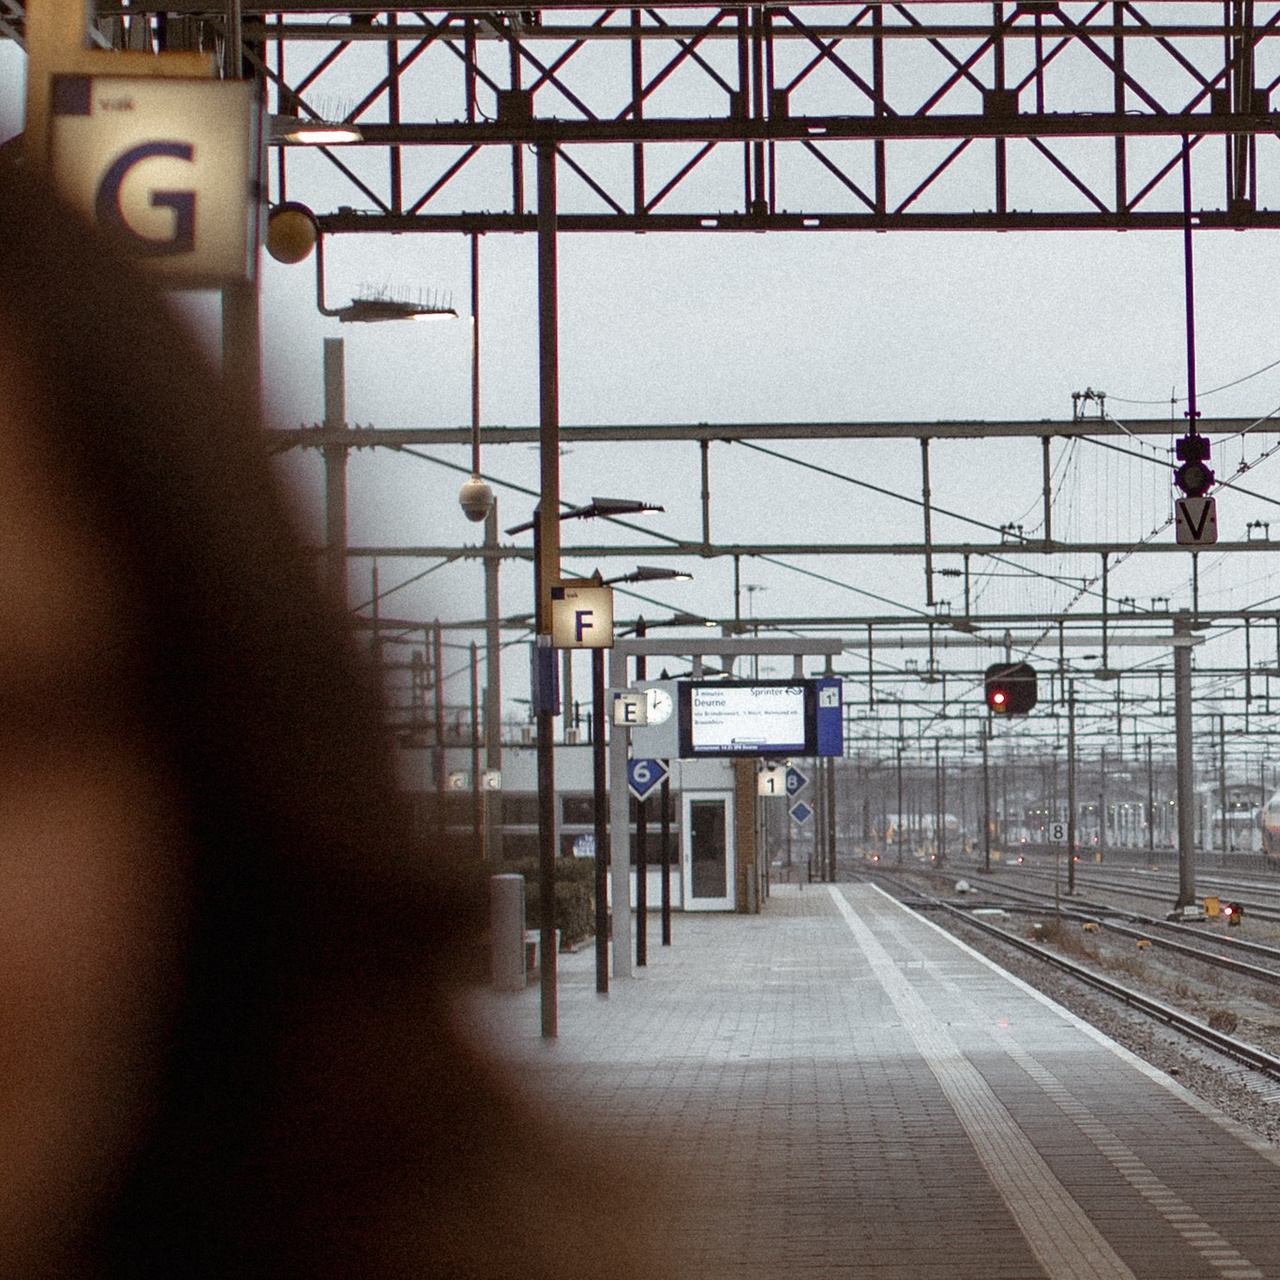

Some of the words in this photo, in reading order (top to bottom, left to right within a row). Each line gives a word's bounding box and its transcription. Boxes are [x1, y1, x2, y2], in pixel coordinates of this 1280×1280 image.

[95, 140, 196, 257] G
[1180, 500, 1212, 540] V
[575, 610, 593, 642] F
[694, 698, 726, 707] Deurne
[750, 687, 783, 697] Sprinter
[624, 702, 637, 723] E
[633, 761, 651, 783] 6
[767, 777, 775, 793] 1
[1054, 825, 1063, 839] 8
